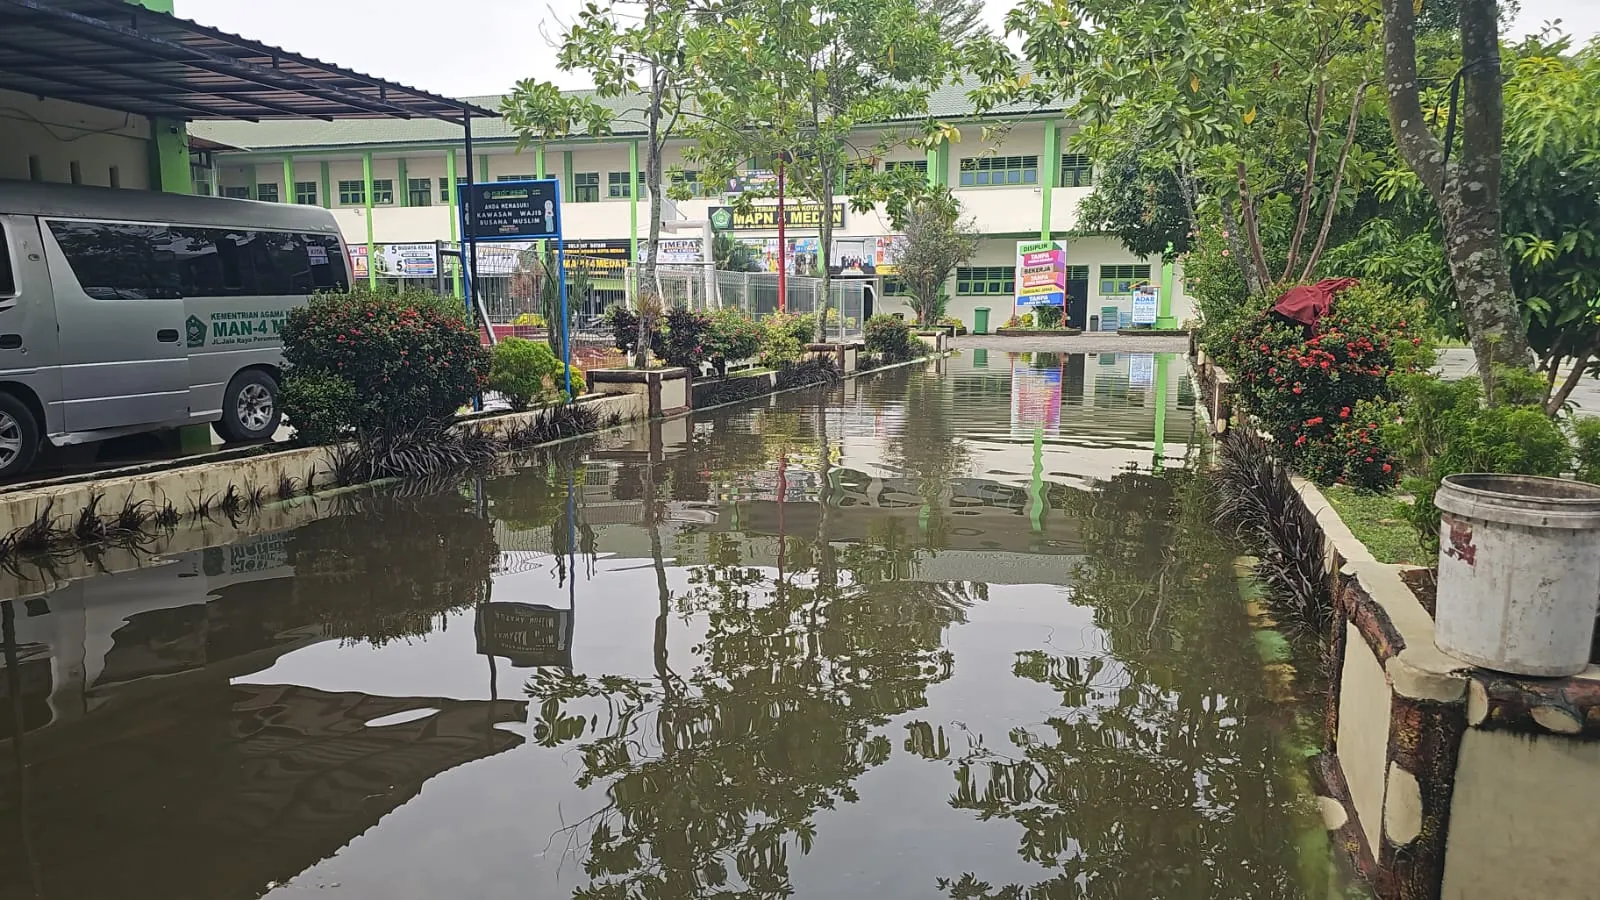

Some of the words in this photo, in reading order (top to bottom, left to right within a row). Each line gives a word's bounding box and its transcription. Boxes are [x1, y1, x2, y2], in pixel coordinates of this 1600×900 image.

[479, 218, 508, 226] BUSANA
[512, 217, 540, 225] MUSLIM
[733, 212, 774, 224] MAPN
[790, 211, 842, 224] MEDN
[391, 245, 397, 254] 5
[1023, 243, 1048, 252] DISIPLIN
[1030, 252, 1050, 260] TANPA
[396, 260, 403, 271] 5
[1024, 266, 1051, 274] BEKERJA
[211, 311, 259, 321] KEMENTRIAN
[260, 310, 284, 318] AGAMA
[213, 320, 268, 337] MAN-4
